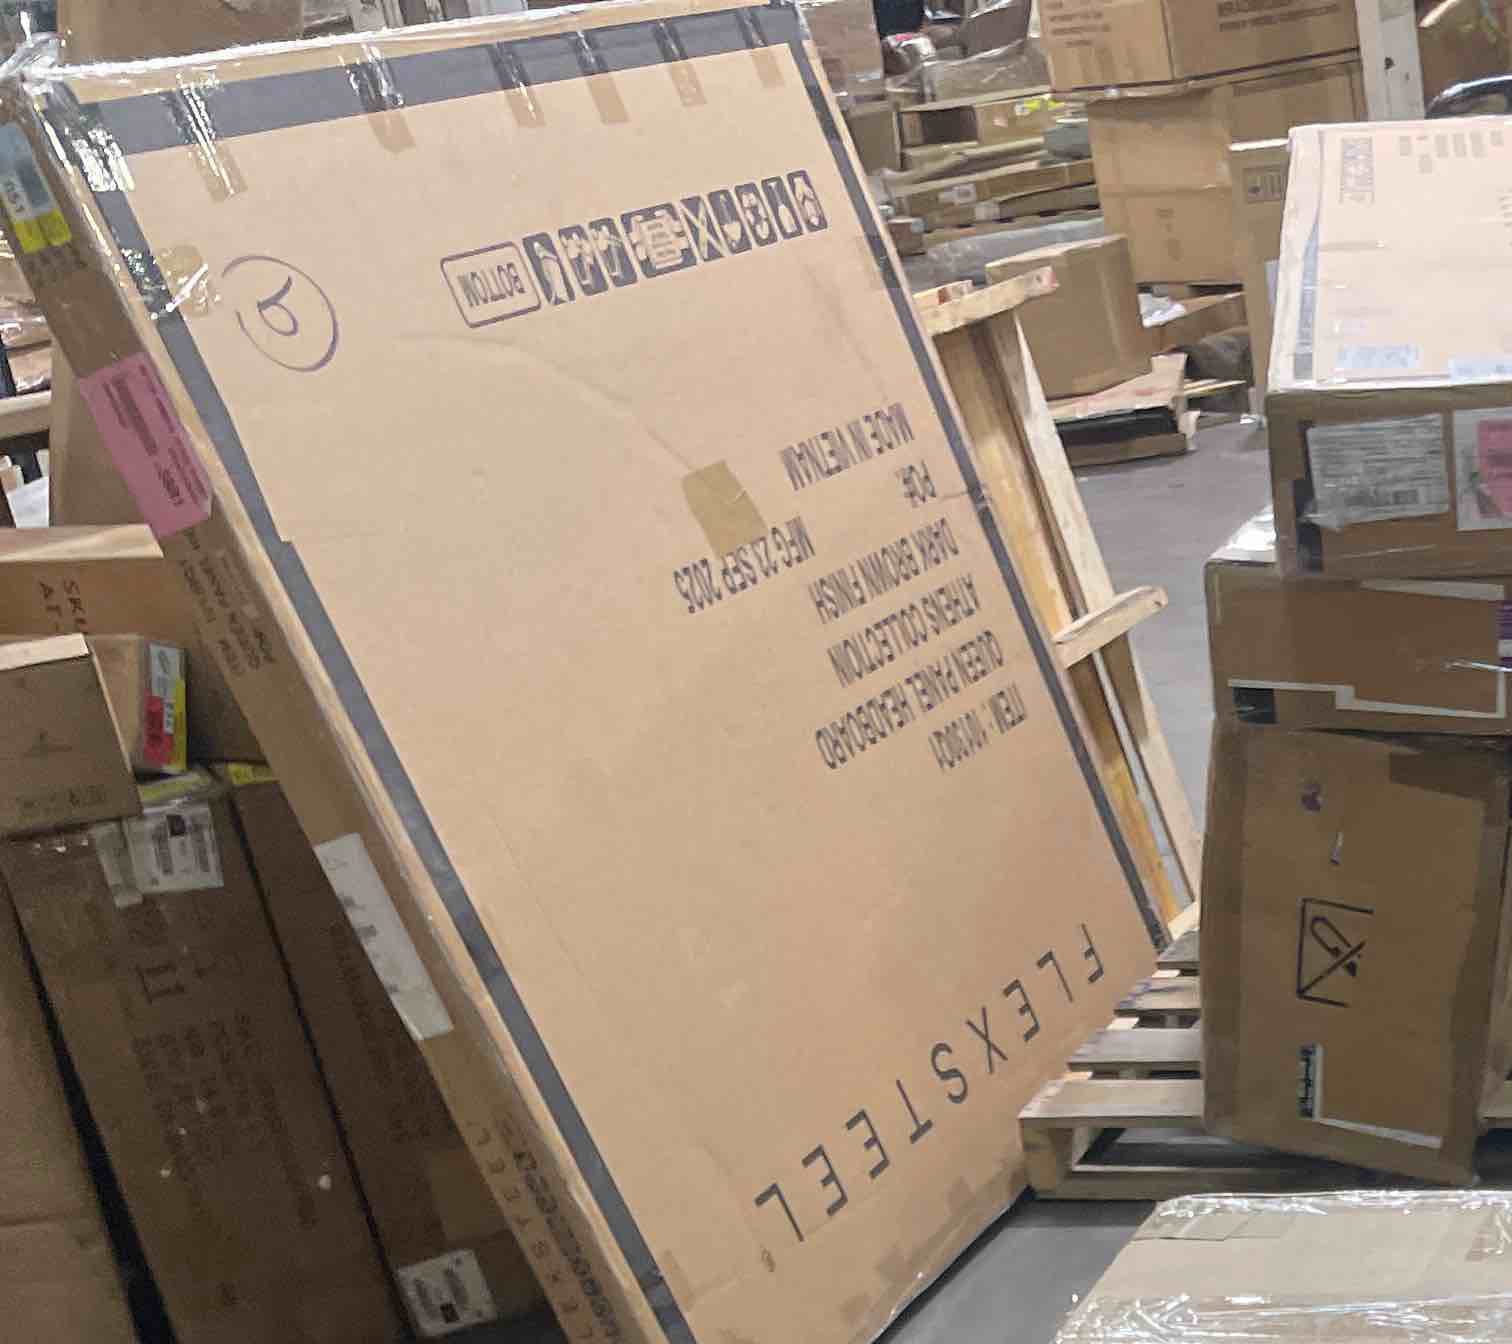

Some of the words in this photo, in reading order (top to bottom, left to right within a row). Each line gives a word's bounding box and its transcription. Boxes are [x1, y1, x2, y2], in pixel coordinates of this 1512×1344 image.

[457, 262, 526, 307] BOTTOM
[864, 401, 915, 454] MADE
[780, 426, 858, 491] VIETNAM
[720, 547, 758, 595] SEP
[770, 516, 816, 569] MFG
[856, 537, 921, 600] BROWN
[911, 517, 960, 572] DARK
[673, 558, 723, 614] 2025
[808, 564, 867, 625] FINISH
[921, 573, 981, 635] ATHENS
[827, 603, 928, 688] COLLECTION
[951, 629, 1004, 688] QUEEN
[905, 655, 960, 713] PANEL
[815, 683, 917, 770] HEADBOARD
[754, 923, 1104, 1242] FLEXSTEEL
